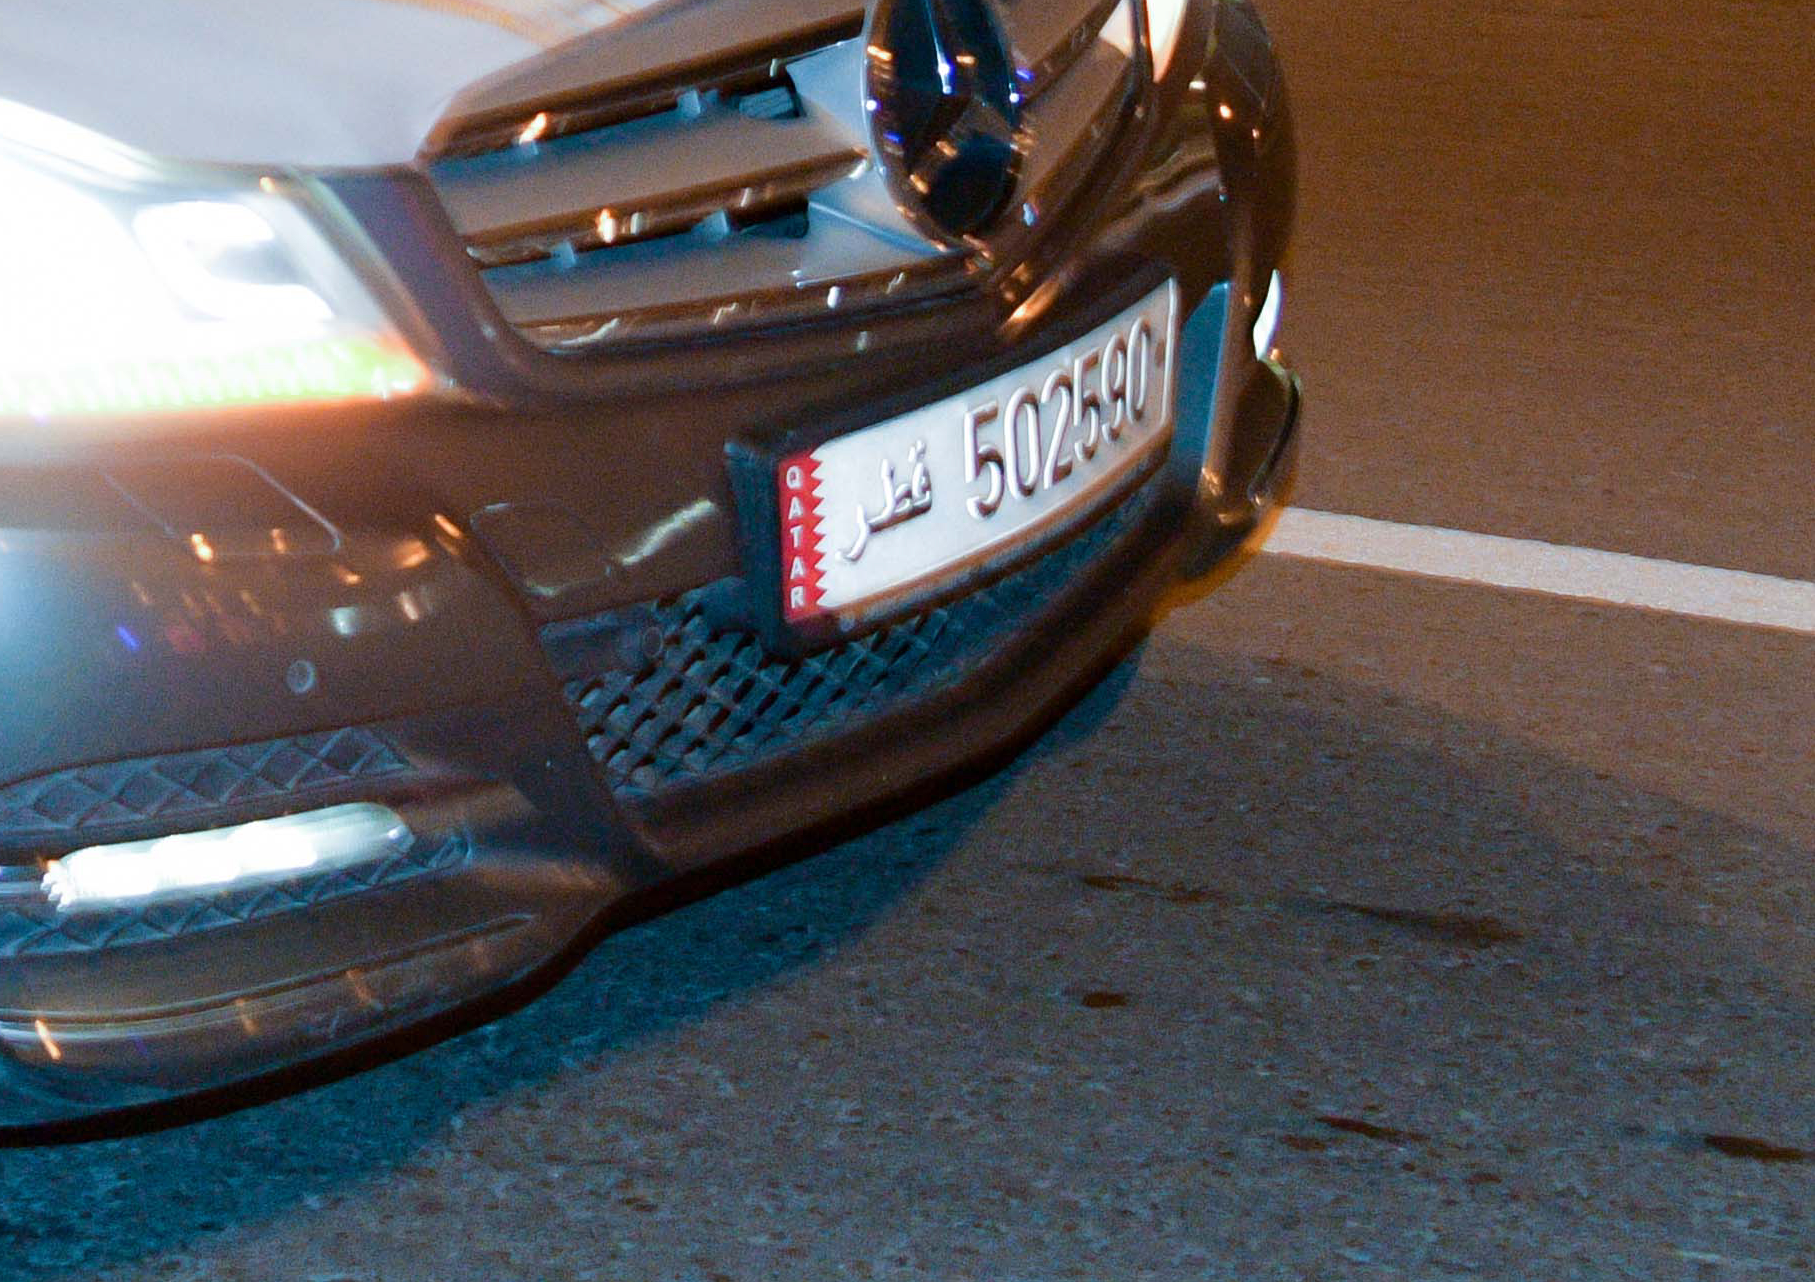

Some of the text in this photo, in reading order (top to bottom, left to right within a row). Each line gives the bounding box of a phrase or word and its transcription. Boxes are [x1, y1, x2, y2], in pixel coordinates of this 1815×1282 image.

[963, 317, 1149, 520] 502590
[786, 465, 805, 610] QATAR
[835, 439, 932, 563] قطر
